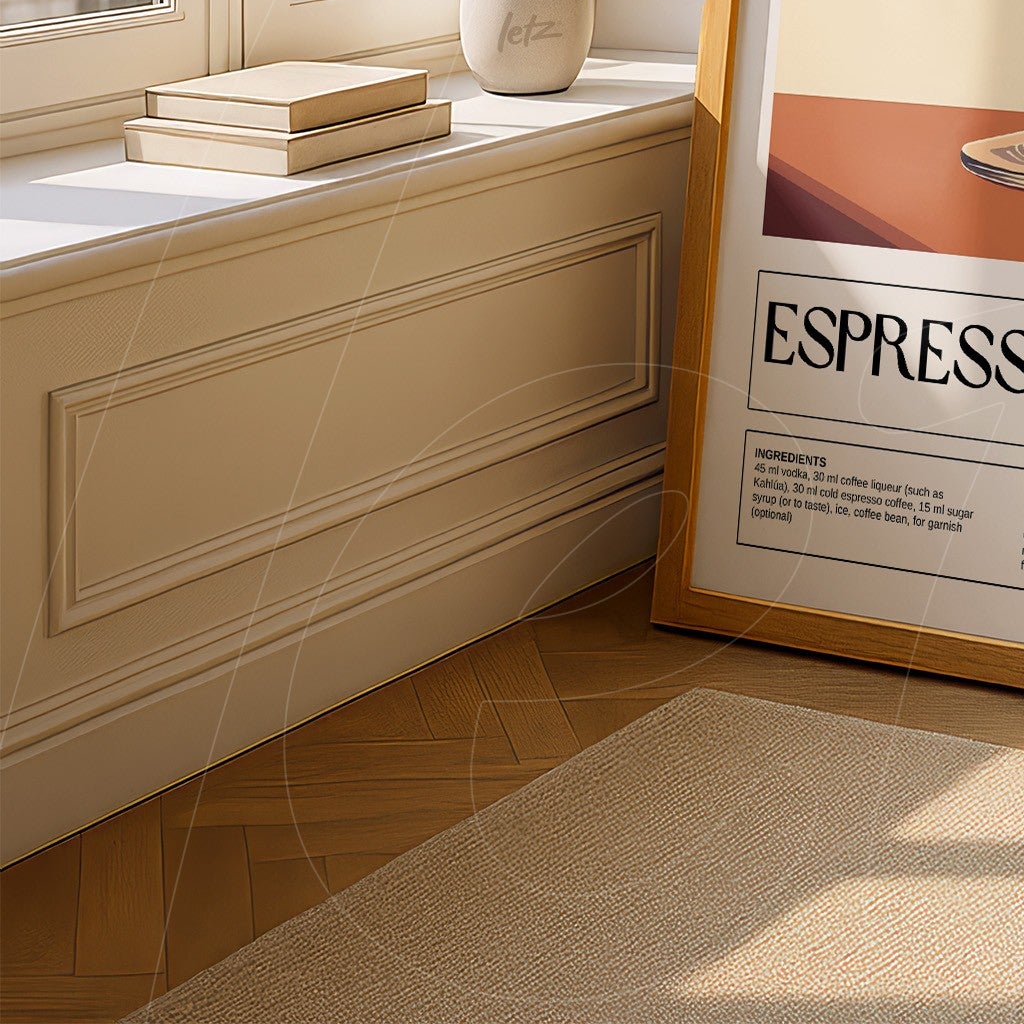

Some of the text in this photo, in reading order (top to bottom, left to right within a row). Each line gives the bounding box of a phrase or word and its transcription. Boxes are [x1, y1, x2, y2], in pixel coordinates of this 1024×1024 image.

[497, 12, 563, 53] letz
[754, 447, 827, 468] INGREDIENTS
[754, 462, 944, 500] 45 ml vodka, 30 ml coffee liqueur (such as
[750, 506, 793, 525] (optional)
[752, 493, 963, 533] syrup (or to taste), ice, coffee bean, for garnish
[792, 482, 805, 495] 30
[806, 485, 818, 497] ml
[819, 487, 840, 500] cold
[840, 491, 883, 506] espresso
[884, 497, 916, 513] coffee,
[918, 501, 931, 514] 15
[932, 504, 946, 515] ml
[946, 507, 975, 521] sugar
